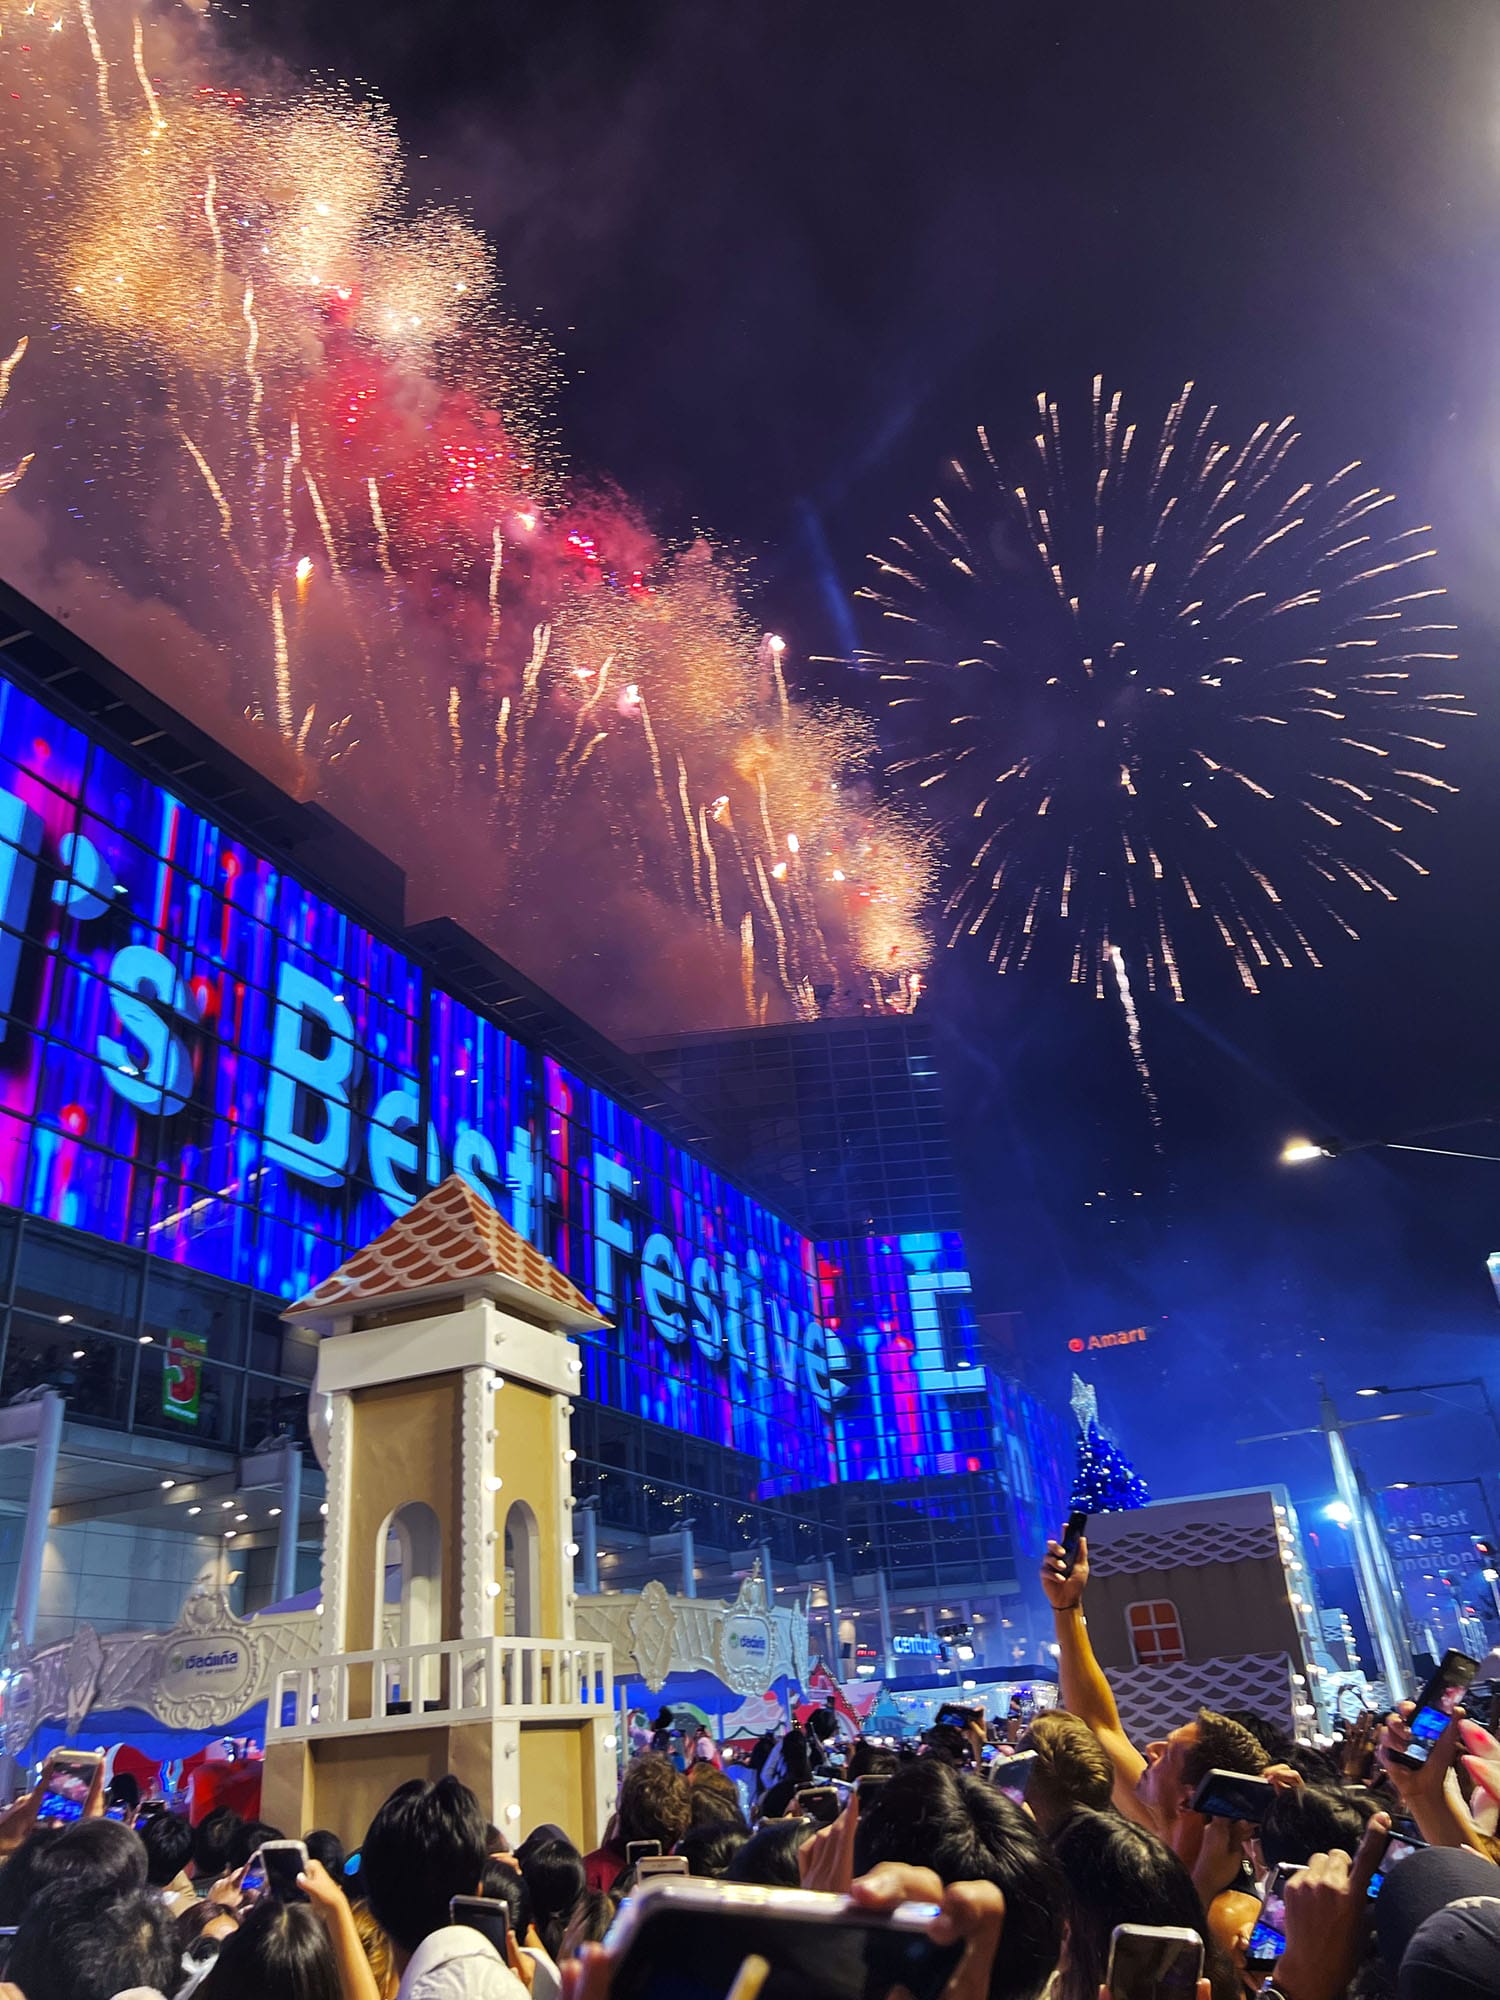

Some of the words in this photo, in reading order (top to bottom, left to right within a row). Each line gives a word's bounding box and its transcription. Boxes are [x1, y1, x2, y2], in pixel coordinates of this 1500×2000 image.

[0, 786, 192, 1112] 's
[263, 962, 552, 1242] Best
[593, 1152, 851, 1413] Festive
[1087, 1328, 1146, 1350] Amari
